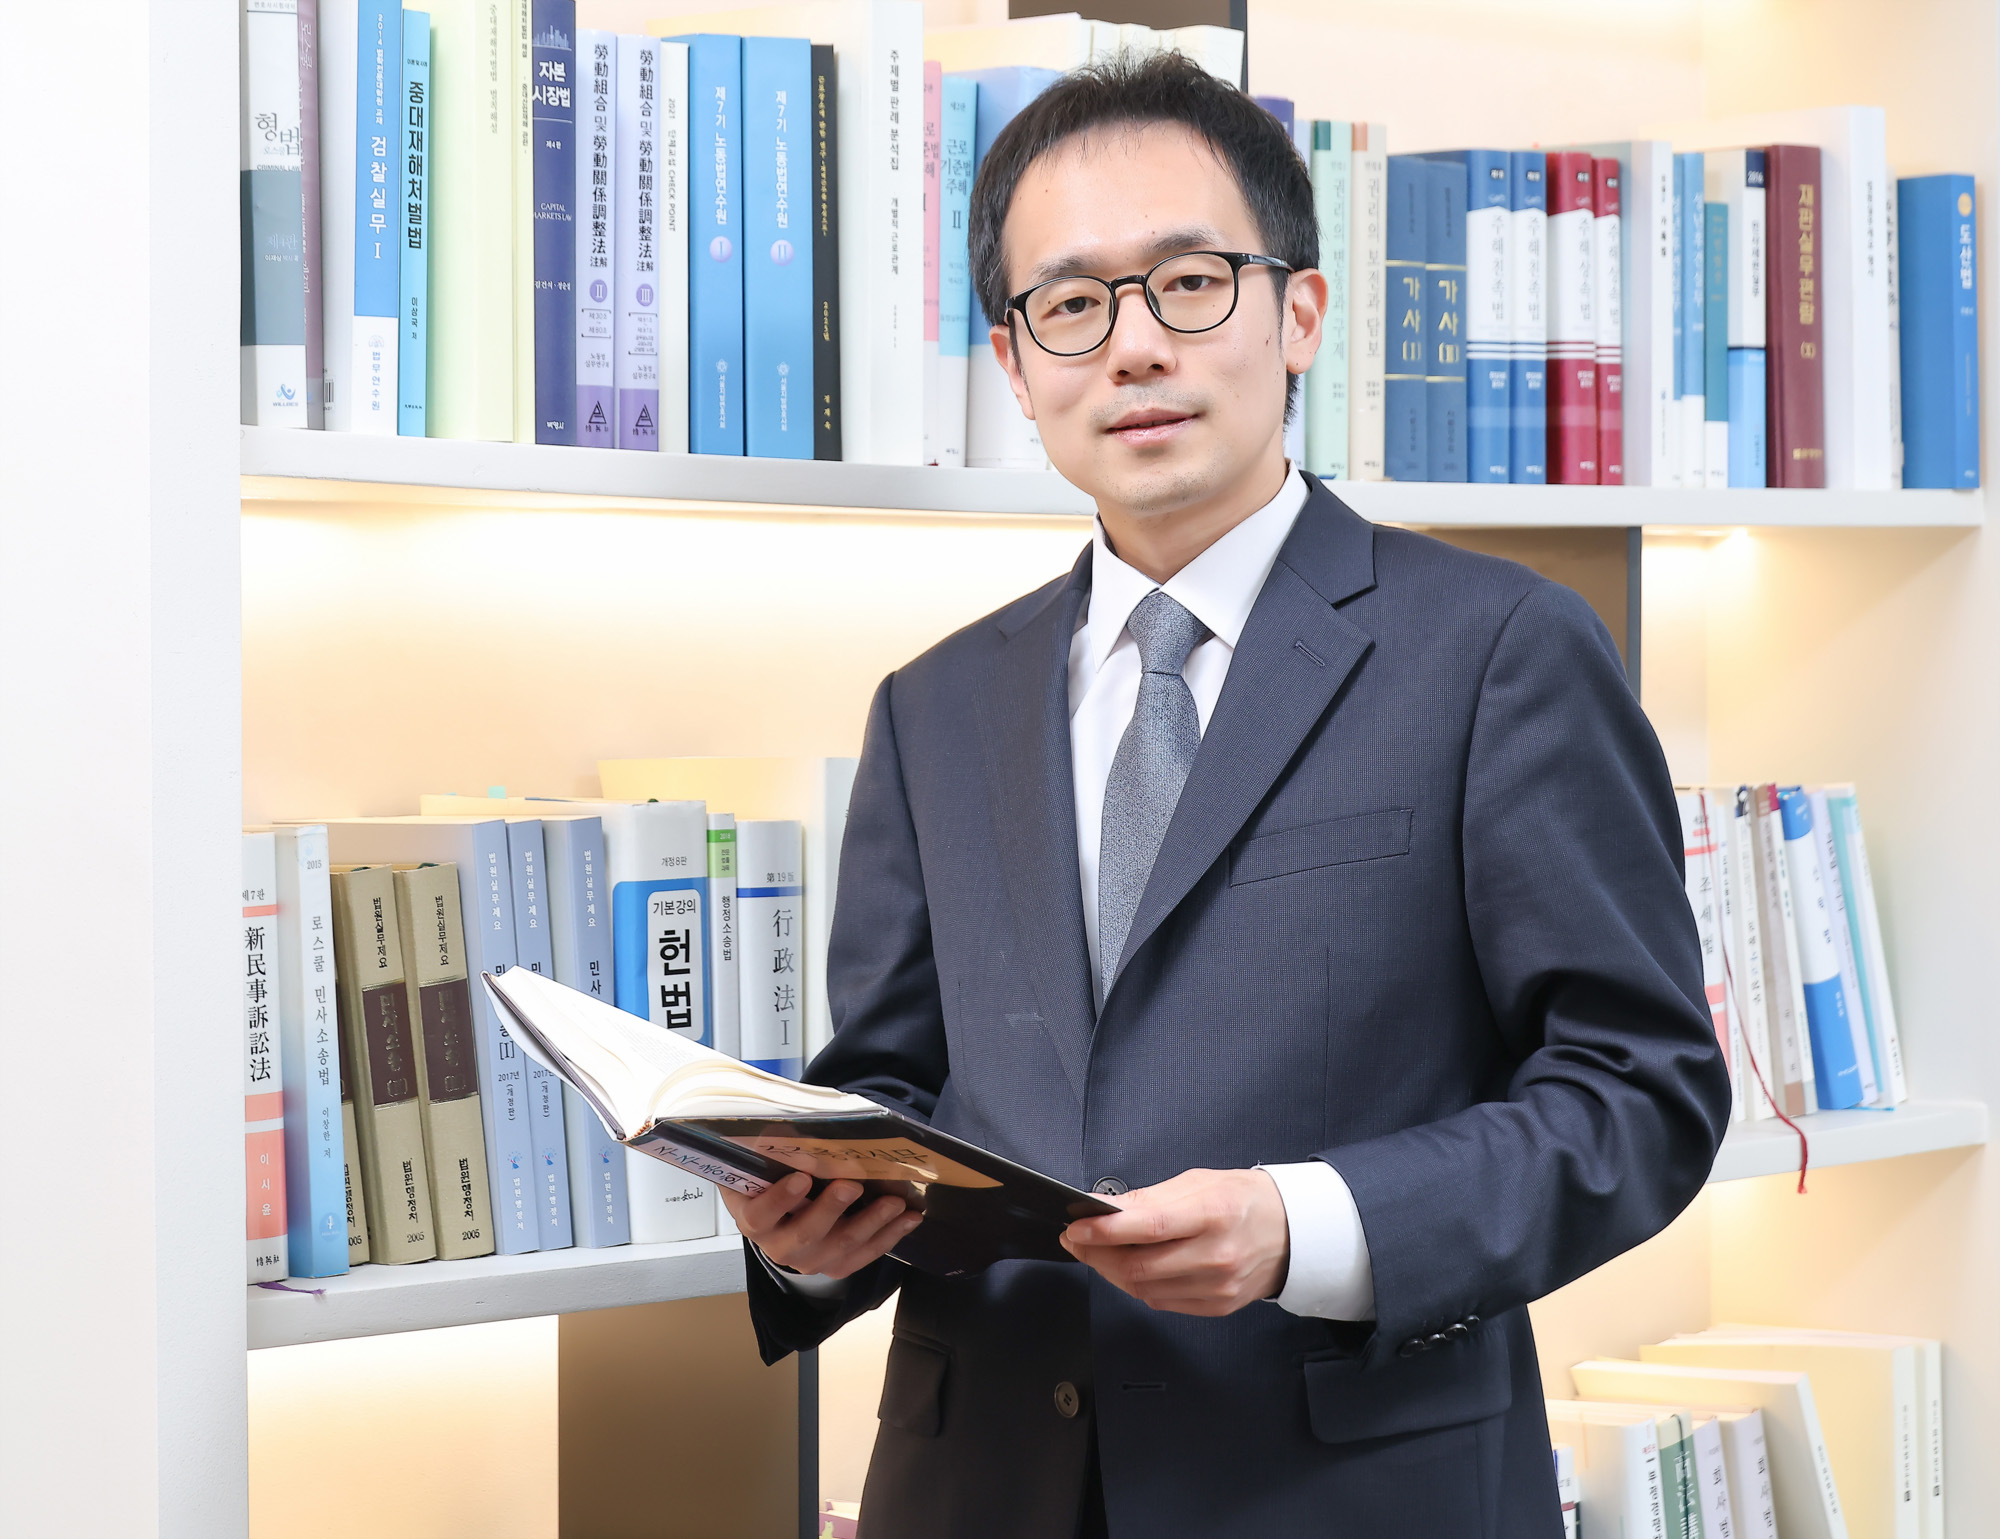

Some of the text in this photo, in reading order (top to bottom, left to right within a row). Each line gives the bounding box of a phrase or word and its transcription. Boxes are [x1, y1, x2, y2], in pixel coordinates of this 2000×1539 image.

[375, 47, 384, 105] 법학전문대학원
[532, 85, 571, 109] 시장법
[538, 61, 566, 82] 자본
[255, 112, 301, 156] 형법
[376, 109, 383, 125] 교재
[889, 50, 900, 171] 주제별 판례 분석집
[408, 82, 424, 249] 중대재해처벌법
[545, 140, 562, 150] 제4판
[592, 44, 608, 254] 勞動組合 및 勞動關係調整法
[638, 50, 653, 258] 勞動組合 및 勞動關係調整法
[714, 86, 728, 225] 제7기 노동법연수원
[776, 91, 789, 229] 제7기 노동법연수원
[941, 159, 971, 177] 기준법
[946, 139, 968, 156] 근로
[369, 136, 388, 234] 검찰실무
[540, 202, 566, 212] CAPITAL
[946, 178, 968, 196] 주해
[1333, 178, 1345, 243] 권리의
[1368, 178, 1380, 243] 권리의
[561, 213, 572, 222] LAW
[1367, 250, 1380, 312] 보전과
[1798, 183, 1815, 326] 재판실무편람
[1333, 317, 1345, 360] 구제
[1367, 318, 1381, 358] 담보
[371, 351, 381, 411] 법무연수원
[306, 860, 322, 870] 2015
[488, 852, 503, 930] 법원실무제요
[525, 850, 538, 928] 법원실무제요
[584, 850, 596, 927] 법원실무제요
[661, 856, 688, 867] 개정8판
[373, 897, 388, 968] 법원실무제요
[435, 895, 449, 966] 법원실무제요
[653, 898, 697, 916] 기본강의
[722, 895, 732, 961] 행정소송법
[659, 928, 692, 1029] 헌법
[773, 909, 795, 1012] 行政法
[245, 926, 271, 1083] 新民事訴訟法
[311, 916, 330, 1086] 로스쿨 민사소송법
[498, 1071, 520, 1083] 2017년
[260, 1153, 272, 1217] 이시윤
[402, 1159, 419, 1223] 법원행정처
[459, 1157, 475, 1221] 법원행정처
[513, 1177, 524, 1231] 법원행정처
[547, 1174, 558, 1227] 법원행정처
[603, 1172, 614, 1224] 법원행정처
[349, 1235, 363, 1247] 005
[407, 1232, 425, 1244] 2005
[462, 1229, 481, 1241] 2005
